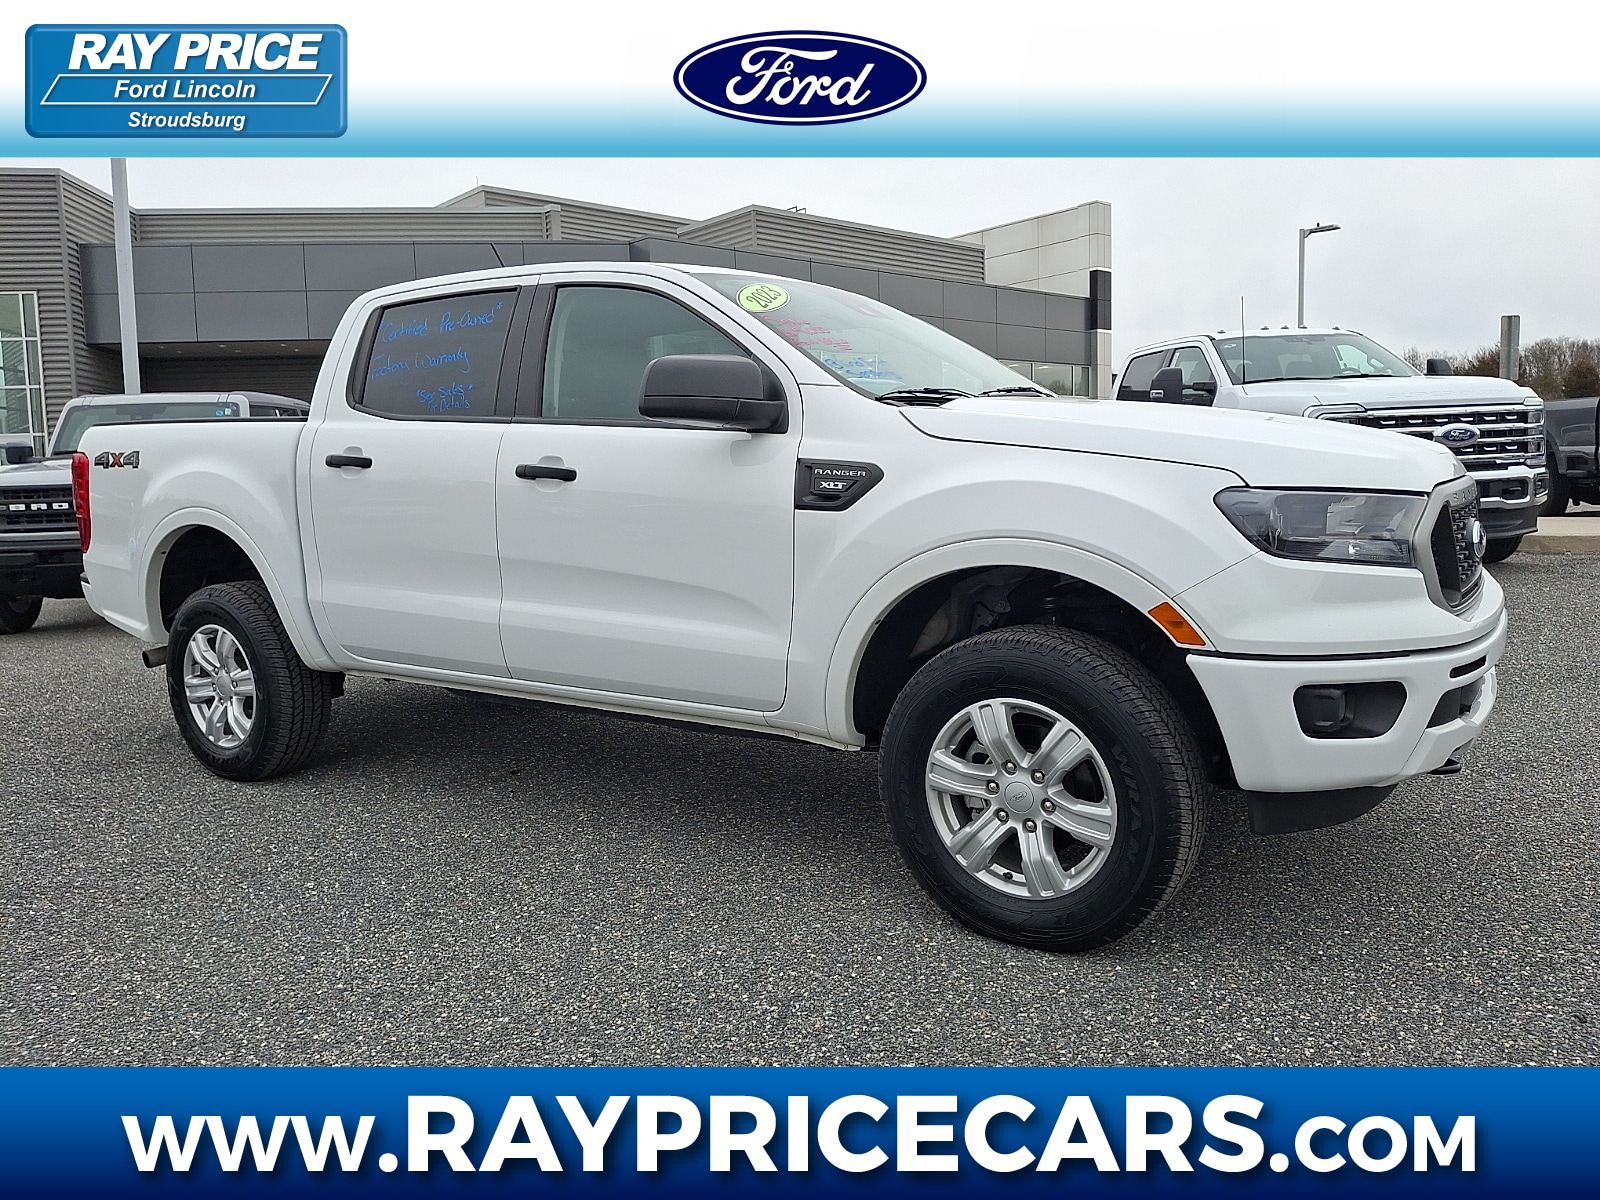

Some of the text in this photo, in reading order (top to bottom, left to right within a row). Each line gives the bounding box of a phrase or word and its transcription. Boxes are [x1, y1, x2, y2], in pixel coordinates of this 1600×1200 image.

[745, 285, 782, 309] 2023
[1449, 430, 1471, 440] Ford
[814, 468, 867, 477] RANGER
[819, 481, 847, 490] XLT
